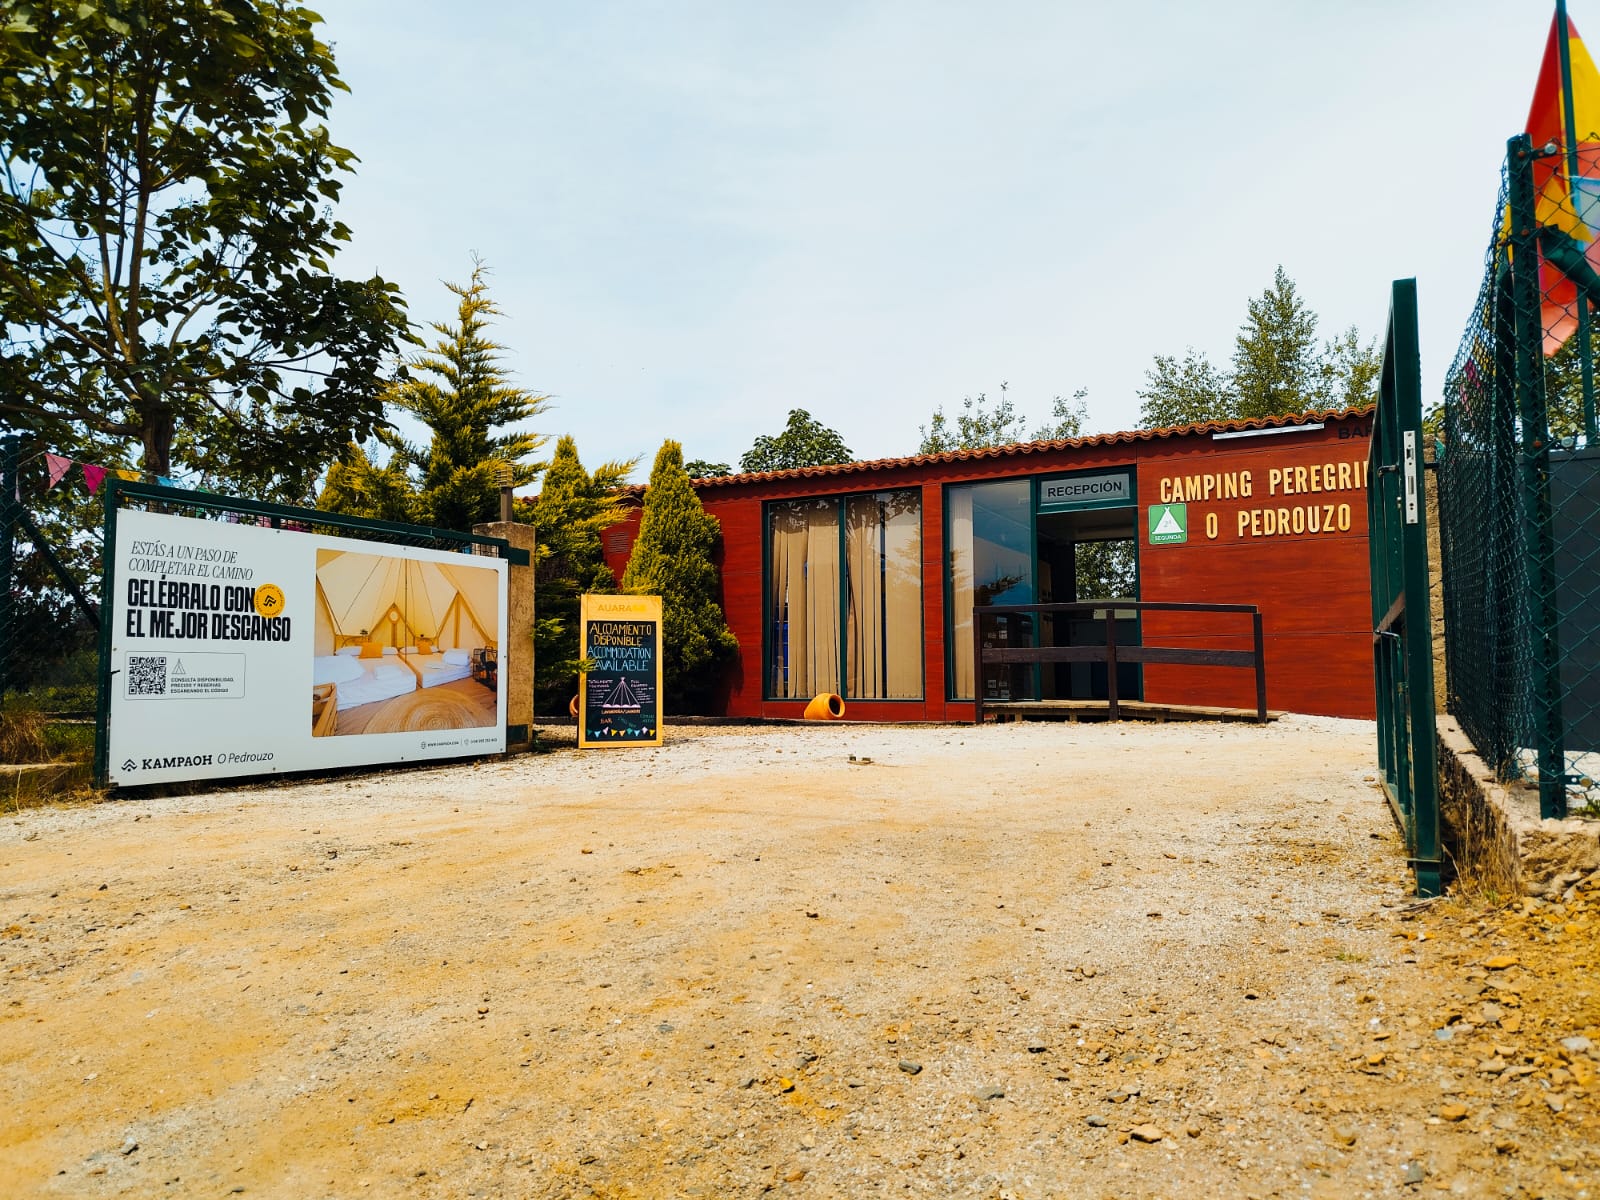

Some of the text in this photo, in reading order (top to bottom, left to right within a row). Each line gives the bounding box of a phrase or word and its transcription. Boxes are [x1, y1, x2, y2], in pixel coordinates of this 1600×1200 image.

[1047, 480, 1122, 498] RECEPCIÓN
[1160, 471, 1252, 504] CAMPING
[1206, 503, 1351, 539] O PEDROUZO
[131, 540, 238, 564] ESTÁS A UN PASO DE
[128, 557, 253, 580] COMPLETAR EL CAMINO
[127, 574, 221, 611] CELÉBRALO
[224, 586, 256, 613] CON
[126, 609, 291, 642] EL MEJOR DESCANSO
[594, 658, 649, 671] AVAILABLE
[142, 751, 274, 770] KAMPAOH O Pedrouzo
